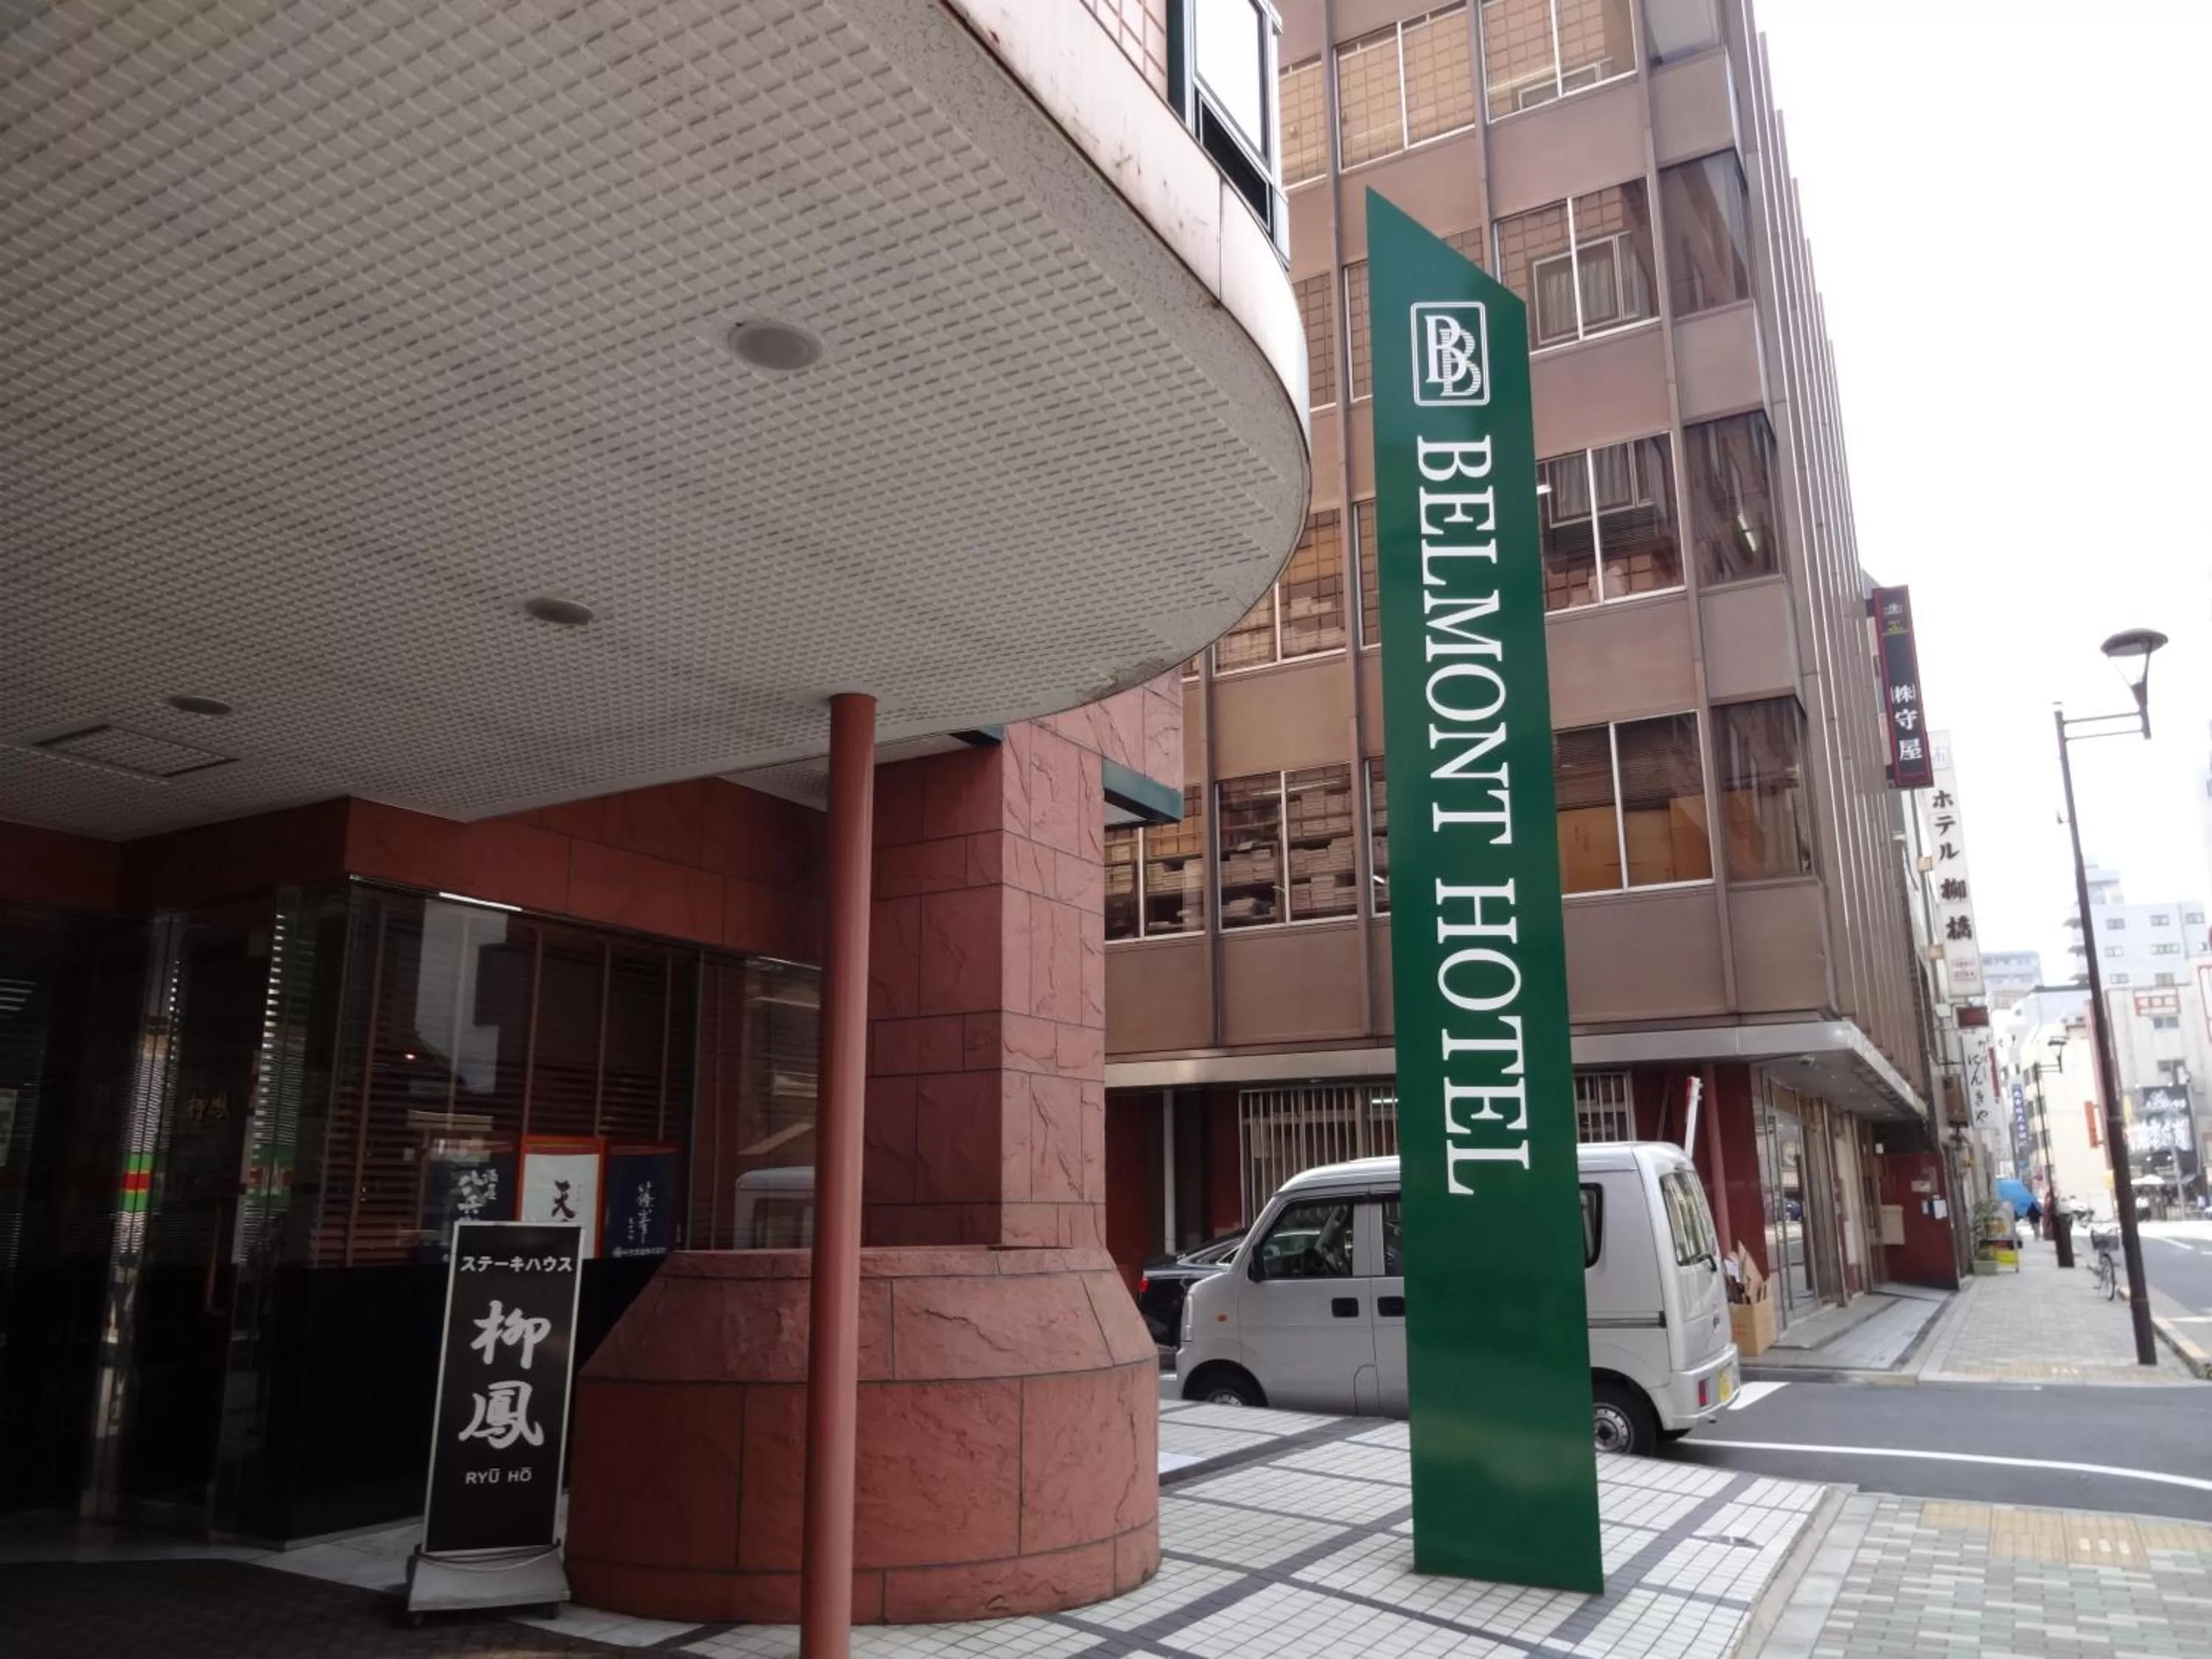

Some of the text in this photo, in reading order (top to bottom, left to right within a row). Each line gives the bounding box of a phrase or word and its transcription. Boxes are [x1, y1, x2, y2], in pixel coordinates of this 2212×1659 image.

[1416, 435, 1530, 1195] BELMONT HOTEL
[460, 1255, 573, 1273] ステーキハウス
[458, 1299, 553, 1450] 柳鳳
